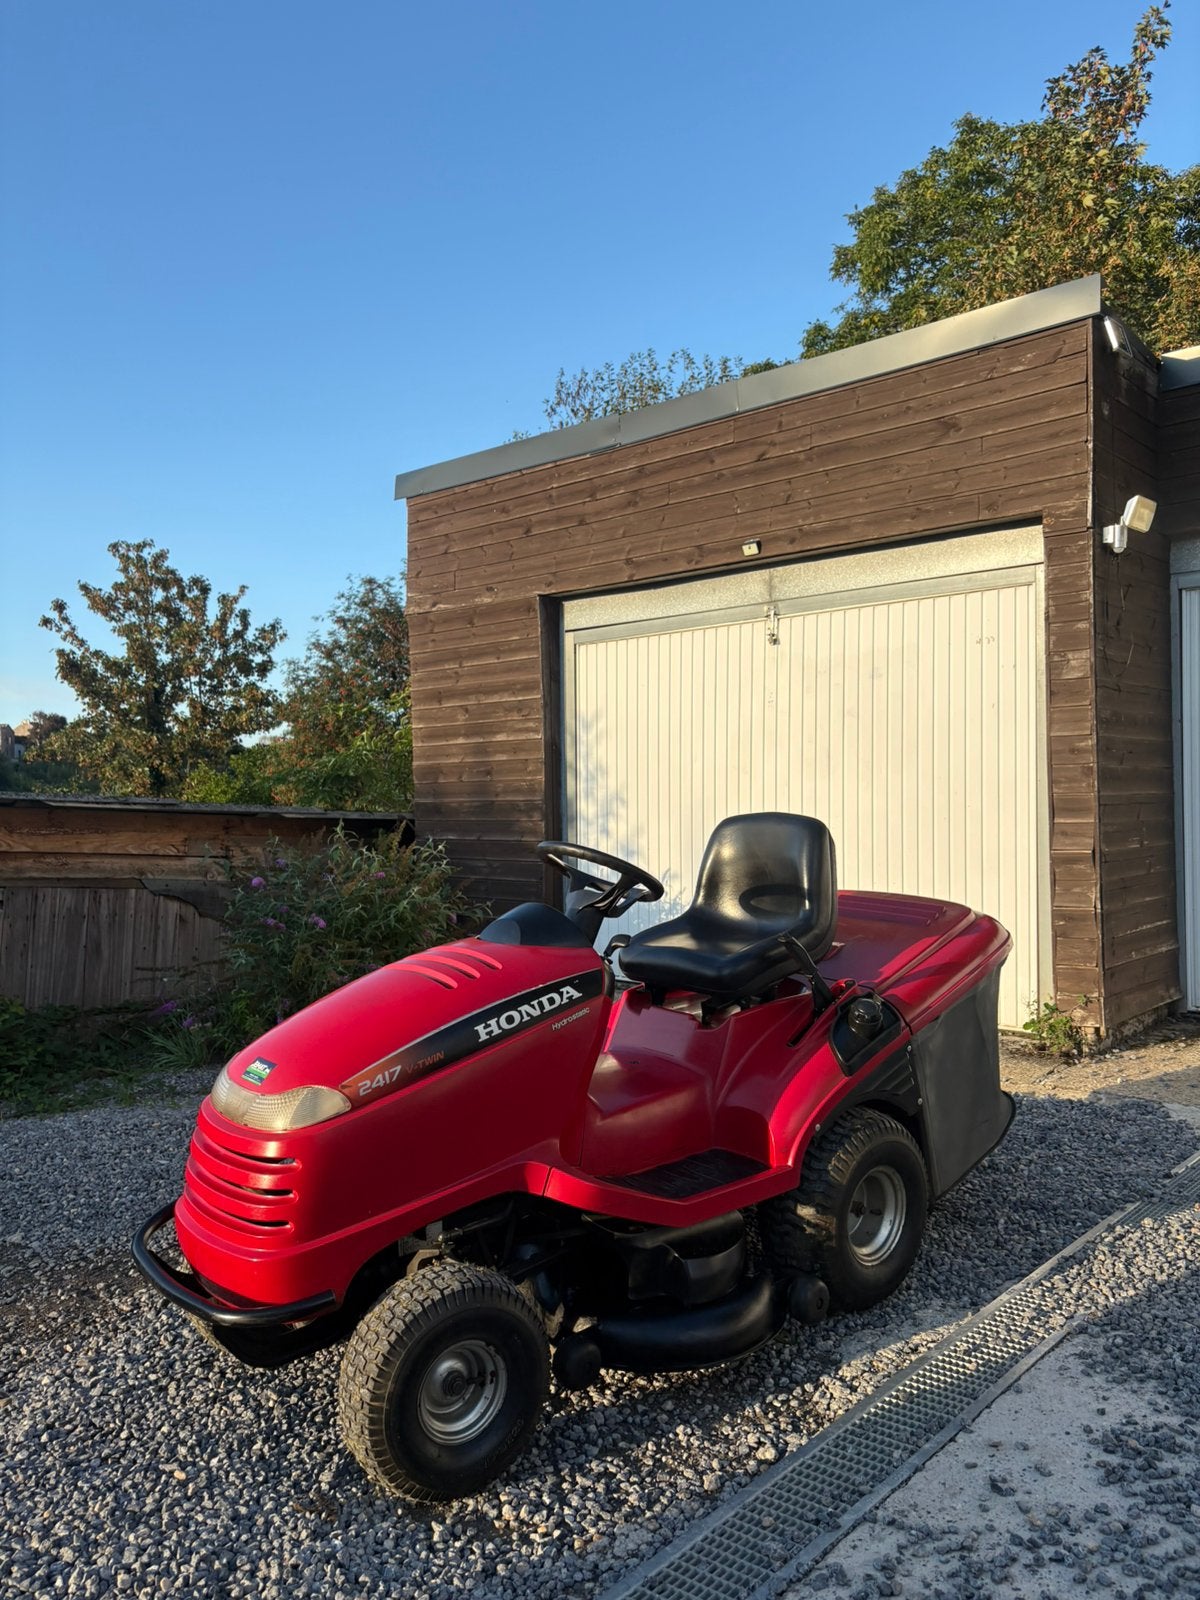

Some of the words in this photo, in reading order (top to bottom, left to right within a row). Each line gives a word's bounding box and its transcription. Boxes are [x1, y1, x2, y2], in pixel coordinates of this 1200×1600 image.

[474, 985, 583, 1043] HONDA
[551, 1007, 591, 1032] Hydrostatic
[357, 1064, 402, 1097] 2417
[404, 1050, 445, 1074] V-TWIN
